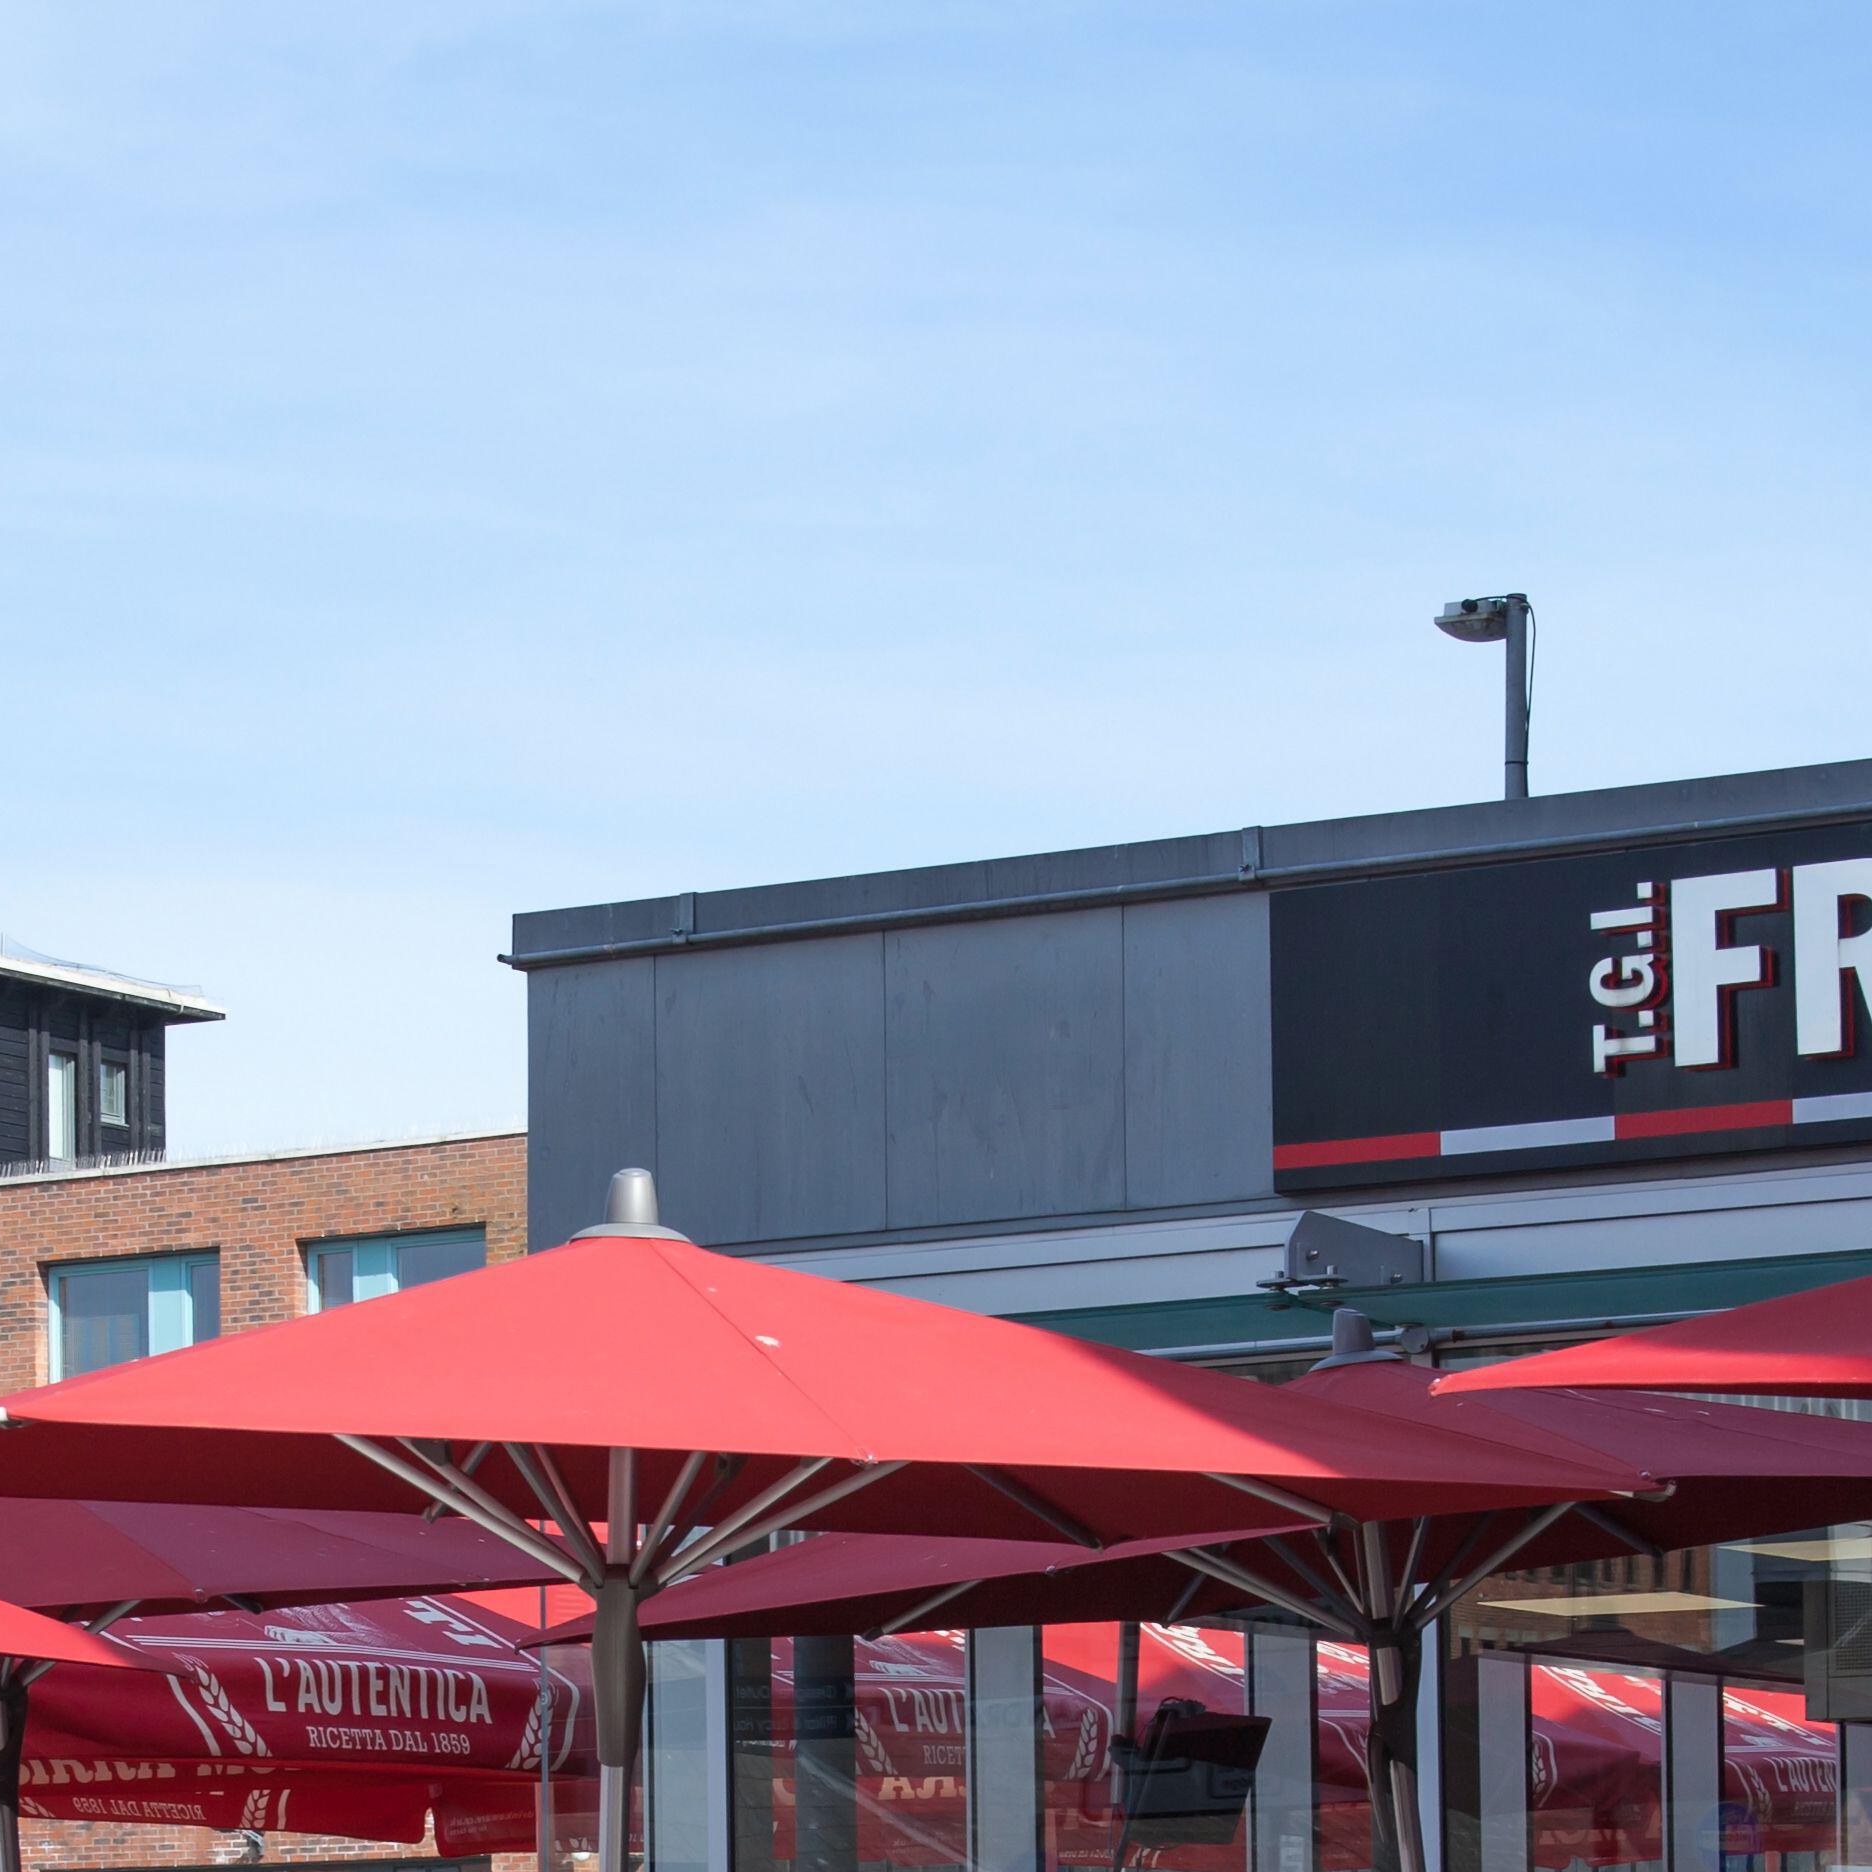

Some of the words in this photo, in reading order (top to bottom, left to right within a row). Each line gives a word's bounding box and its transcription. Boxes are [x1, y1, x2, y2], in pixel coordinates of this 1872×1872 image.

[254, 1657, 493, 1724] L'AUTENTICA
[306, 1726, 388, 1751] RICETTA
[389, 1730, 428, 1753] DAL
[431, 1732, 471, 1755] 1859
